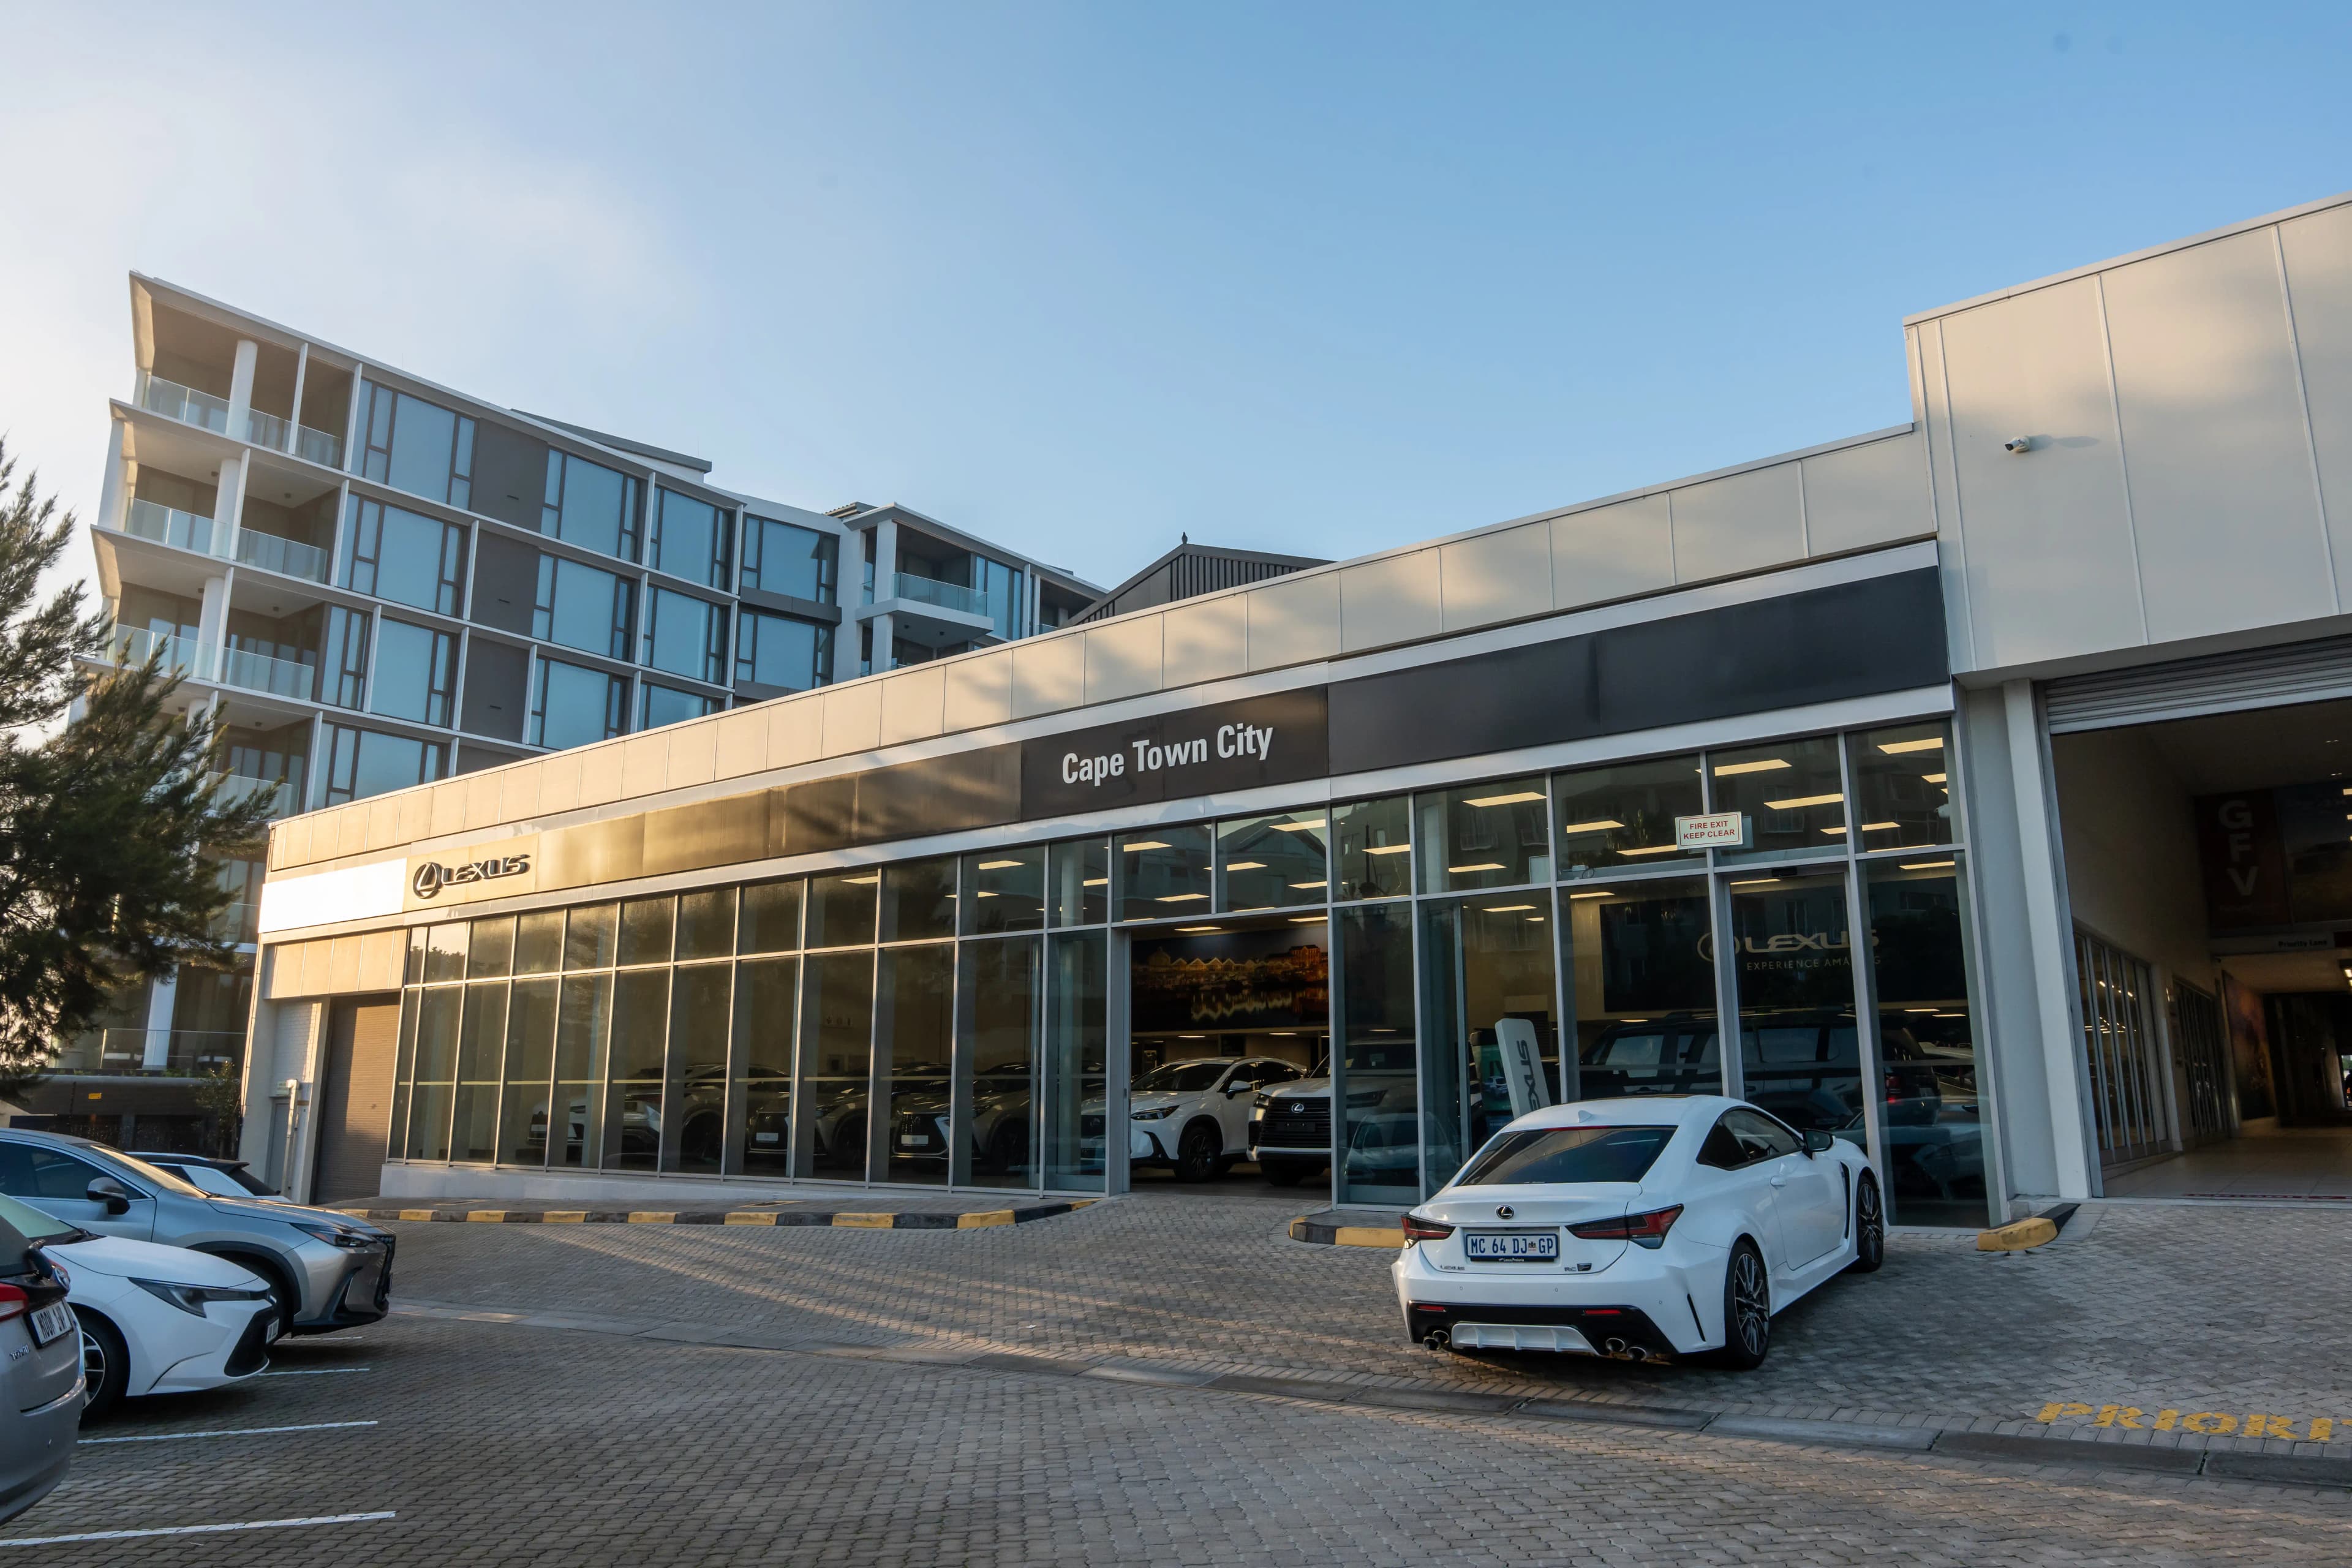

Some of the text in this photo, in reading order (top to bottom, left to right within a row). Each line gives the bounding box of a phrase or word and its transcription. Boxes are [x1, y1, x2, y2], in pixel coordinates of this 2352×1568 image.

[1062, 723, 1273, 786] Cape Town City
[441, 854, 530, 886] LEXUS
[1746, 957, 1881, 971] EXPERIENCE AMAG
[1517, 1040, 1541, 1112] EXUS
[1471, 1237, 1553, 1254] MC 64 DJ GP
